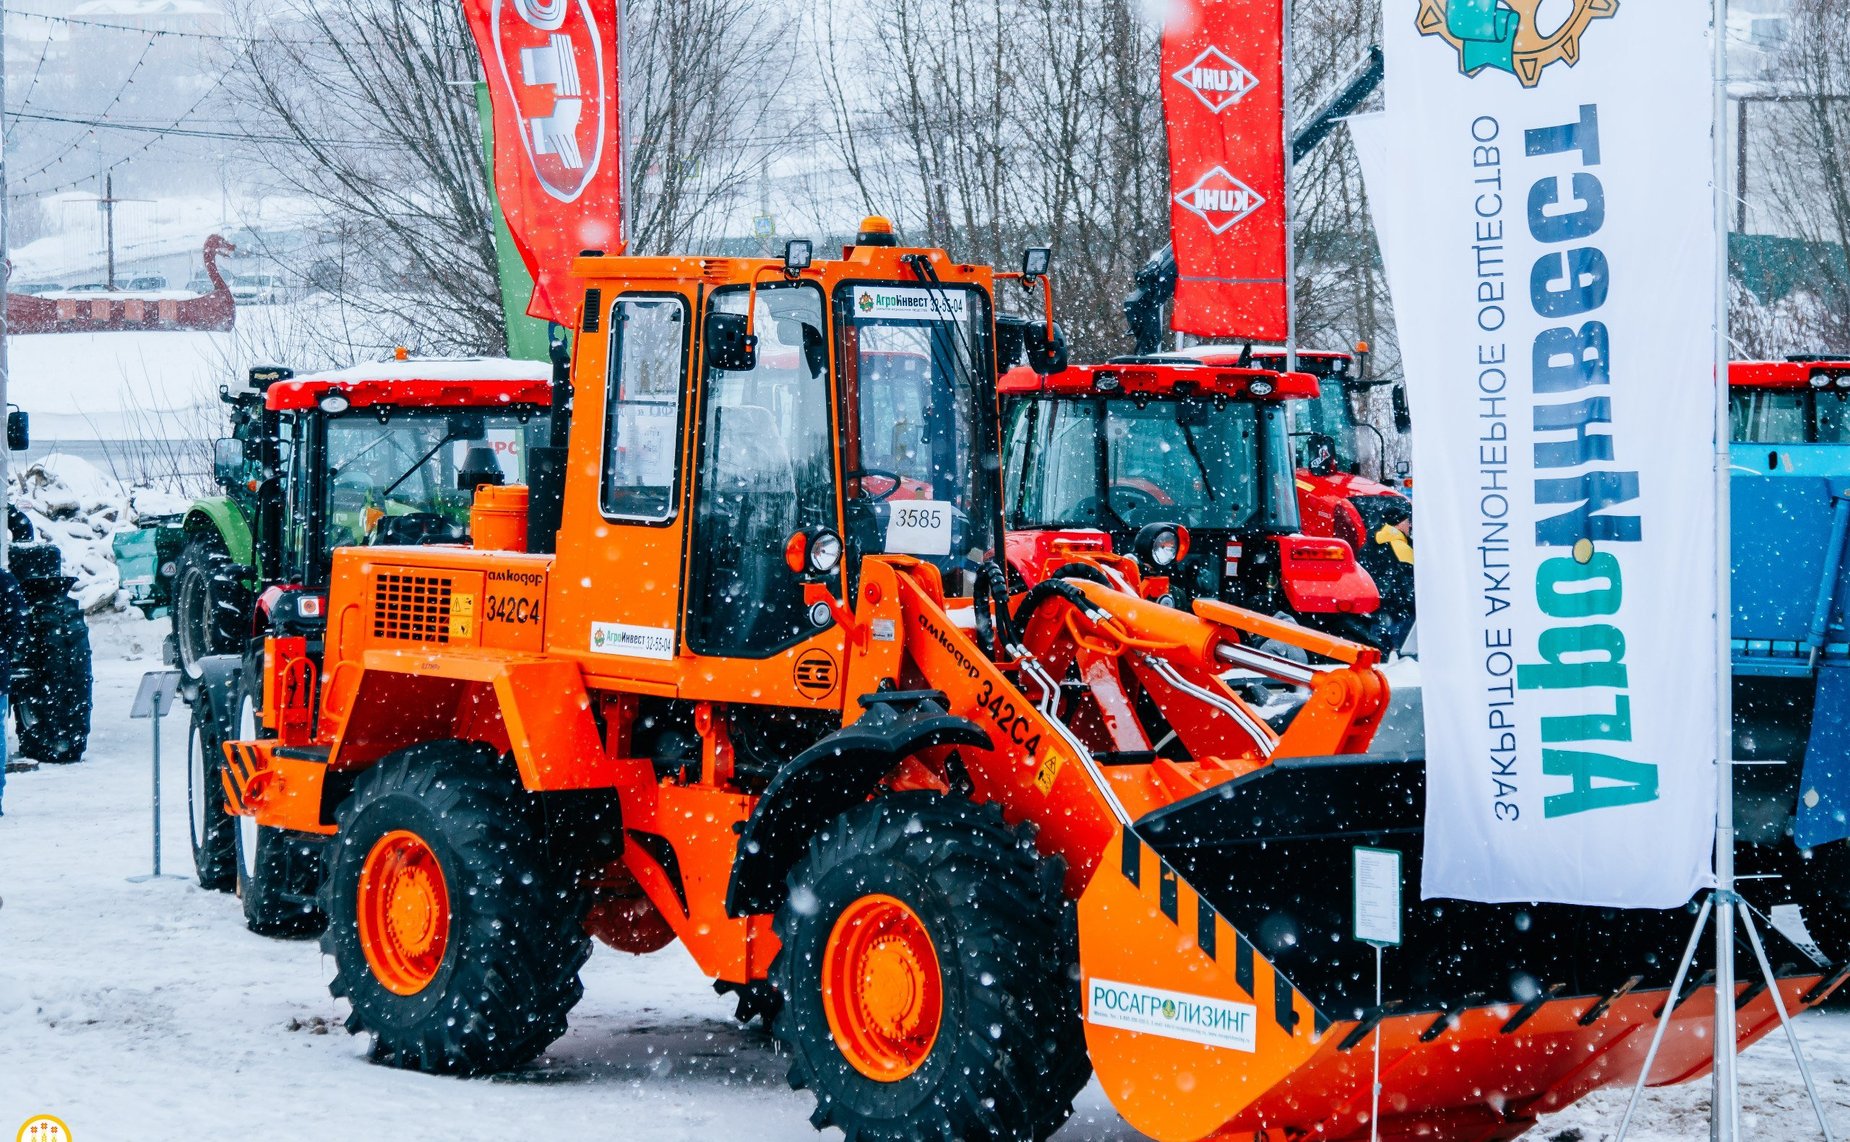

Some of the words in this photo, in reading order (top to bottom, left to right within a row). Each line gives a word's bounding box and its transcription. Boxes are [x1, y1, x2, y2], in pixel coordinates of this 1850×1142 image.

[876, 294, 928, 307] АгроИнвест
[930, 298, 963, 313] 32-55-04
[896, 509, 940, 528] 3585
[606, 630, 645, 646] АгроИнвест
